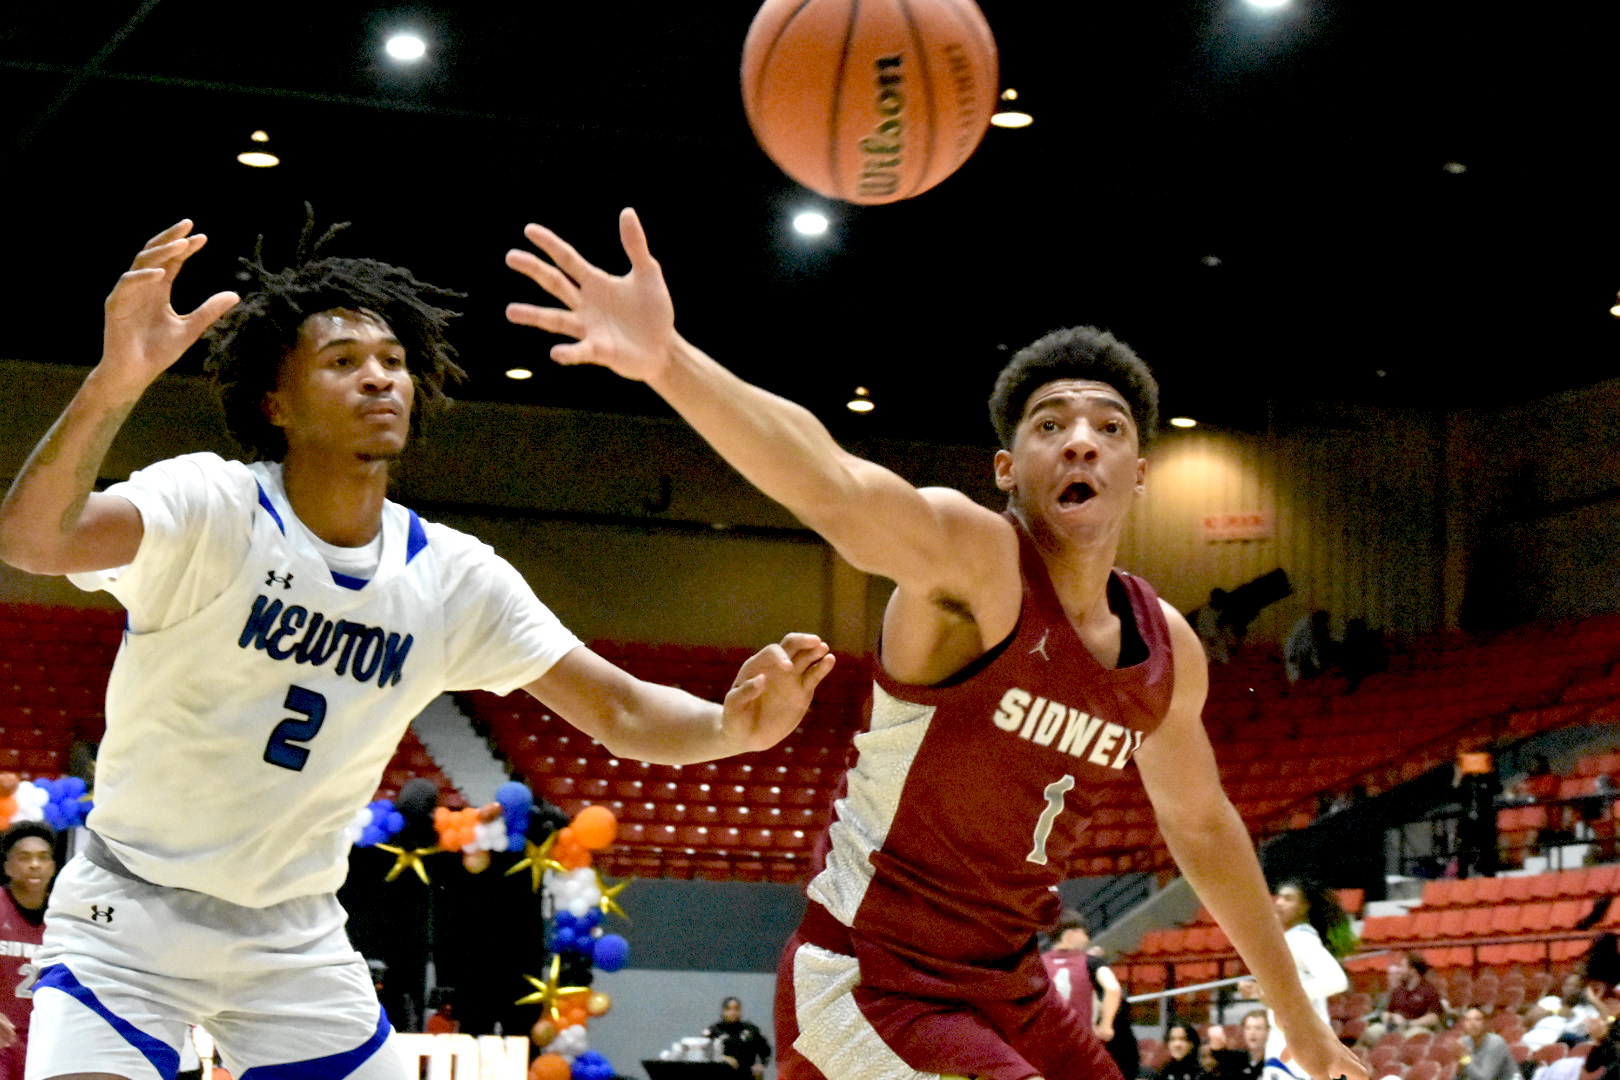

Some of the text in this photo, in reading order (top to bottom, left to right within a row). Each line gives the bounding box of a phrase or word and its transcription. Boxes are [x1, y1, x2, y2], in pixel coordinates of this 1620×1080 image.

[857, 54, 903, 196] Wilson
[238, 594, 414, 688] NEWTON
[263, 684, 327, 772] 2
[1026, 774, 1075, 865] 1
